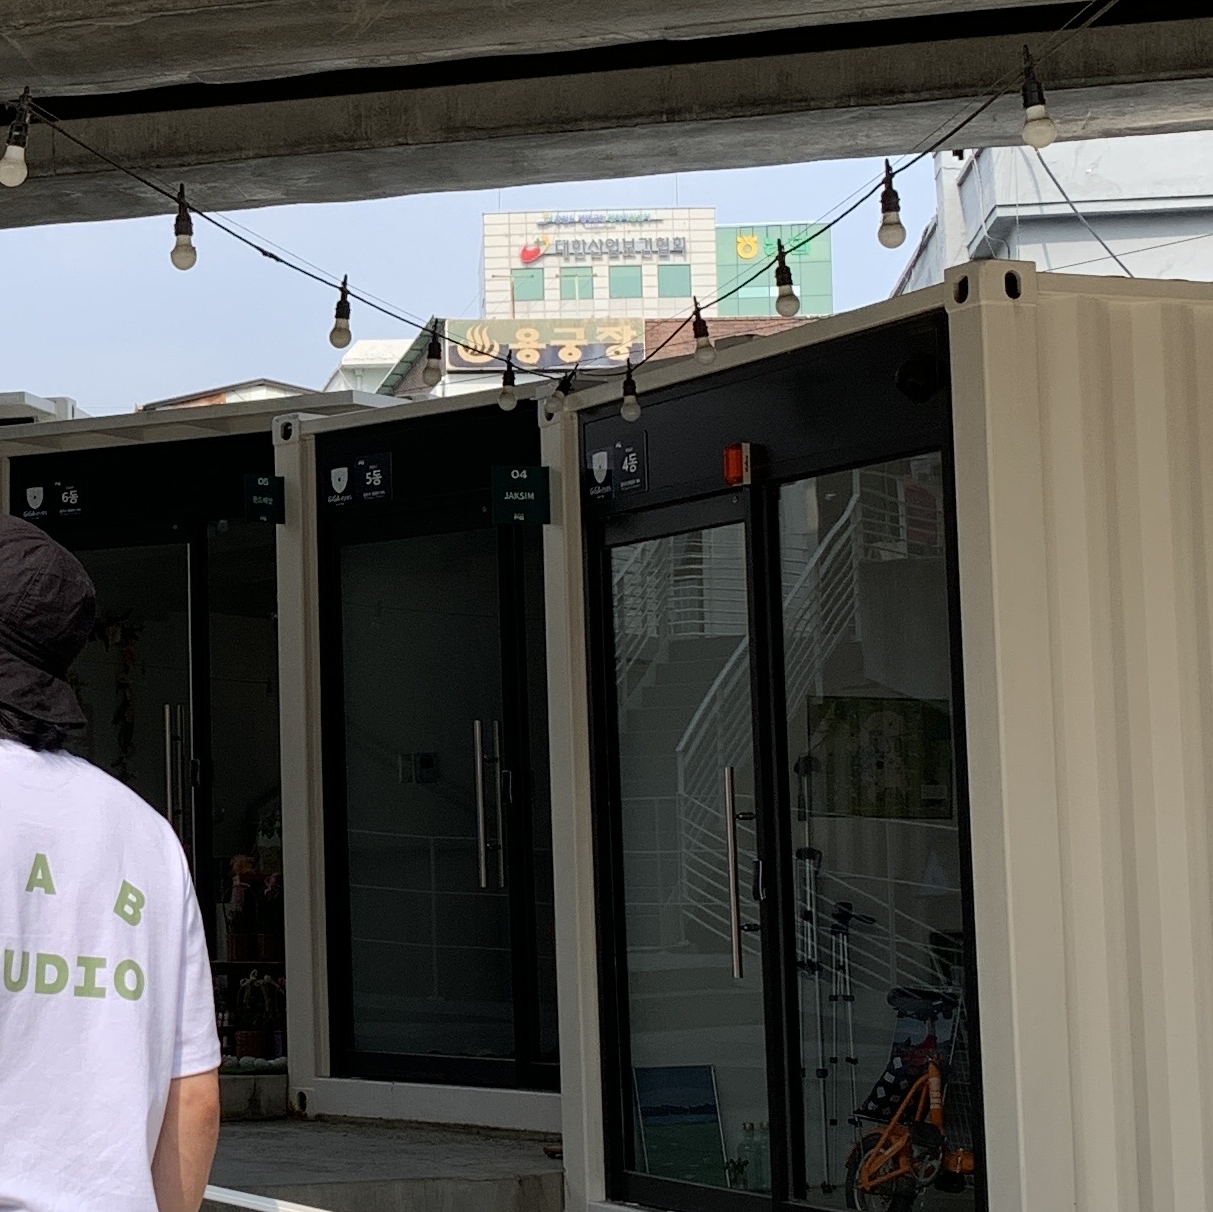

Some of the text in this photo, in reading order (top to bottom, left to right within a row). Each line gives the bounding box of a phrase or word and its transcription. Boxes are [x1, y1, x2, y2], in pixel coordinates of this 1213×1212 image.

[554, 236, 687, 261] 대한산업보건협회
[507, 325, 637, 365] 용궁장
[365, 469, 383, 486] 5동
[510, 469, 528, 480] 04
[61, 489, 79, 505] 6동
[504, 491, 535, 500] JAKSIM
